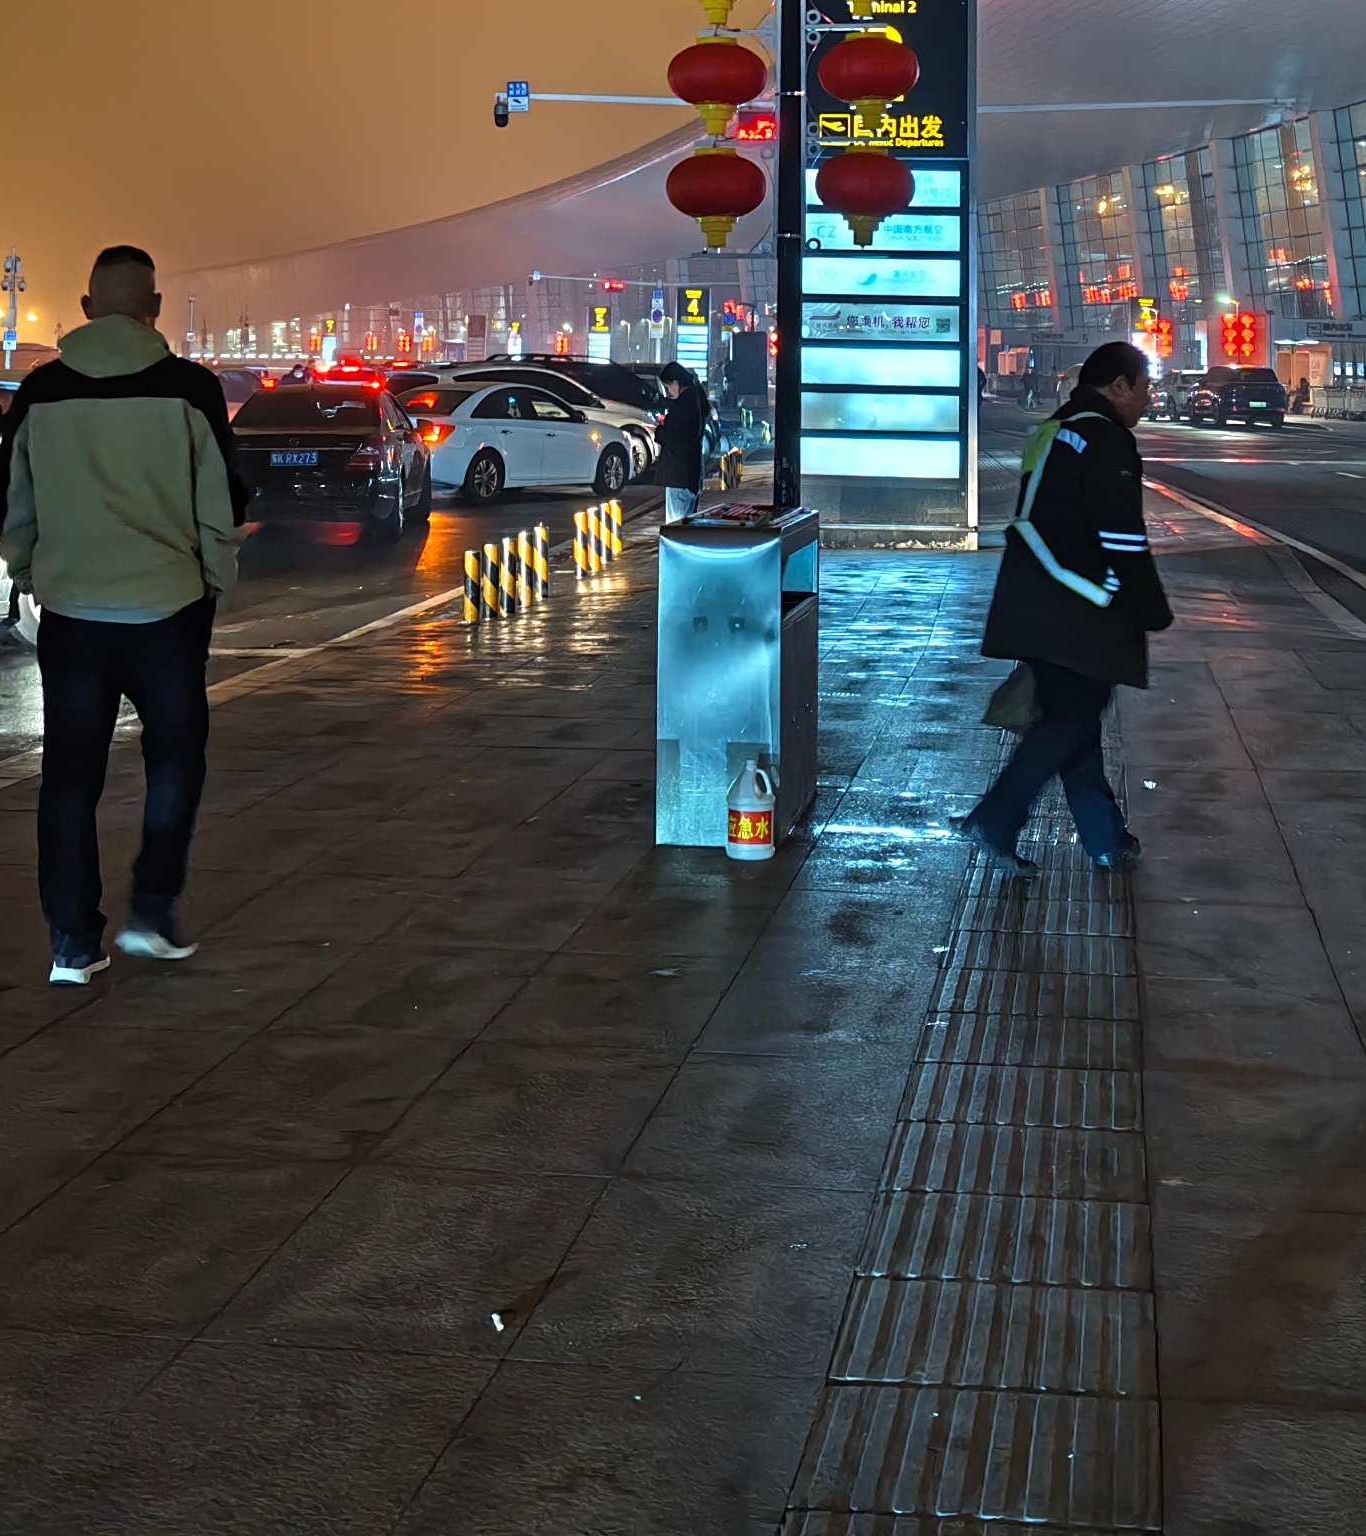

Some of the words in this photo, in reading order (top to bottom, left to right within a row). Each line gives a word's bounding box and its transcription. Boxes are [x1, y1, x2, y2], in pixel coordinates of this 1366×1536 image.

[908, 1, 917, 13] 2
[895, 138, 944, 148] Departures
[687, 299, 699, 315] 4
[595, 313, 605, 327] 5
